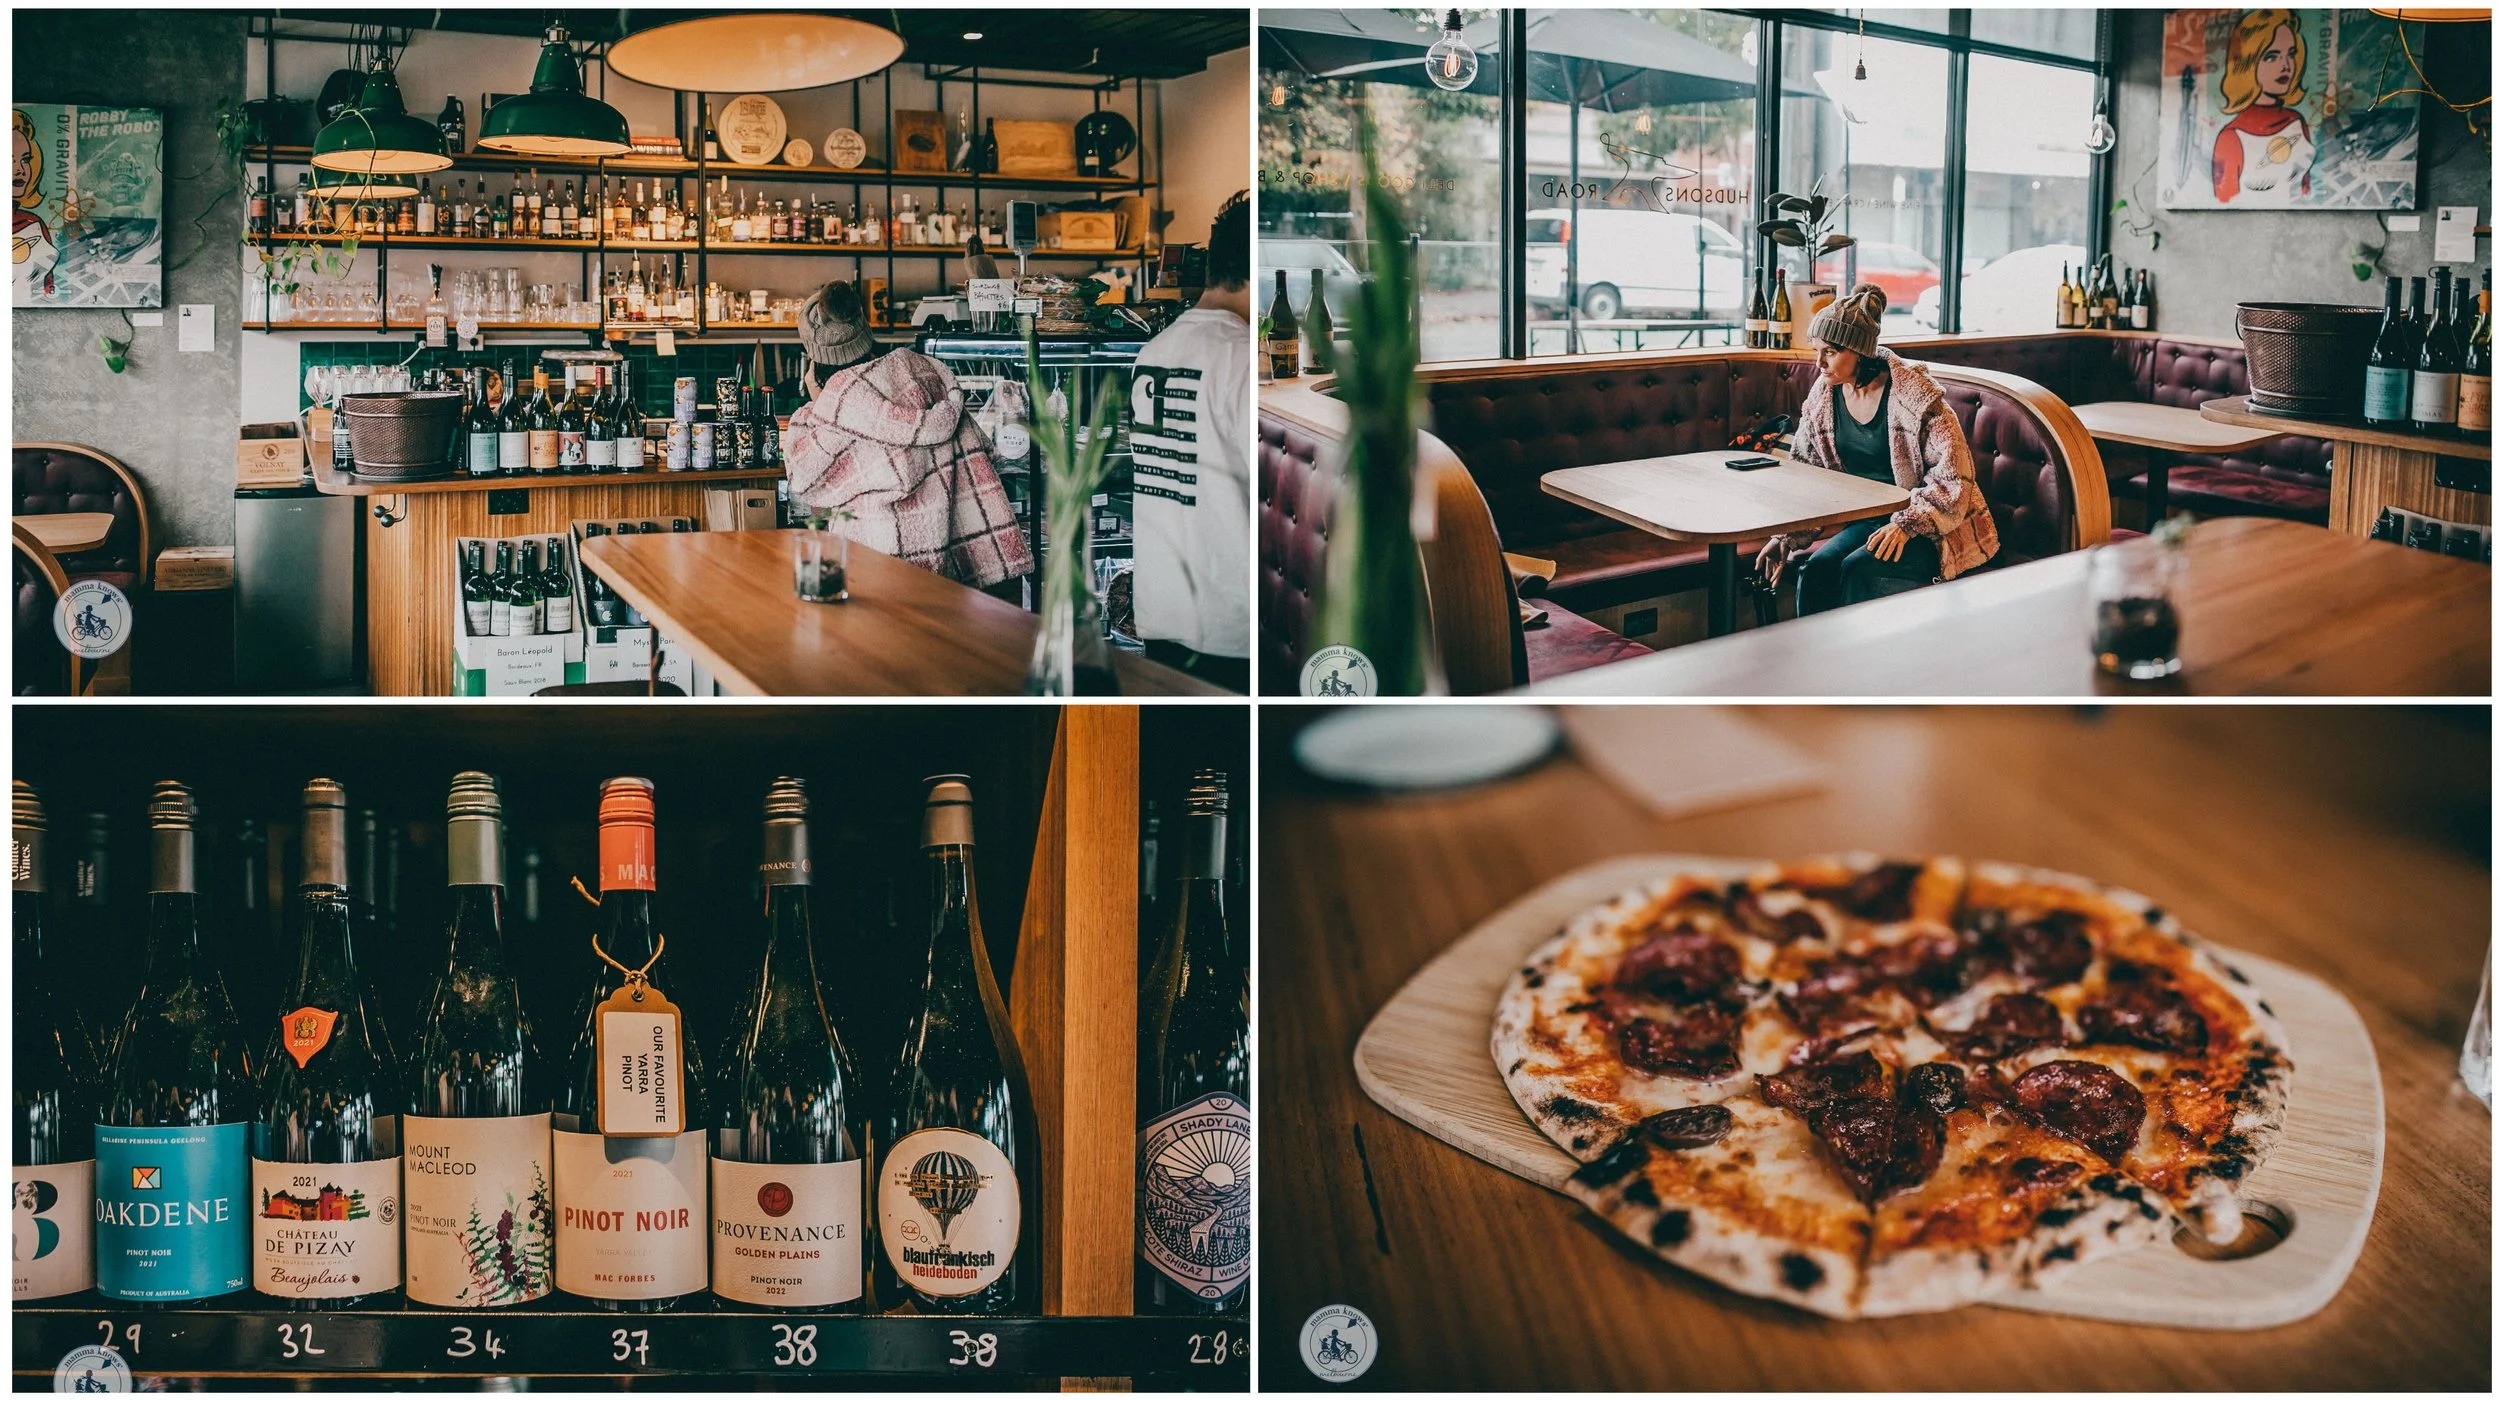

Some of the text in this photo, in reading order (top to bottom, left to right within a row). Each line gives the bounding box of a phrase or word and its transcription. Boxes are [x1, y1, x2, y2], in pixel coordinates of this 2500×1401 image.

[79, 110, 129, 125] ROBBY
[79, 125, 109, 139] THE
[20, 843, 31, 881] Wines.
[293, 1039, 314, 1047] 2021
[622, 1056, 632, 1092] PINOT
[638, 1053, 649, 1094] YARRA
[653, 1025, 666, 1123] OUR FAVOURITE
[1215, 1098, 1227, 1106] 20
[1180, 1117, 1223, 1133] SHADY
[409, 1144, 451, 1159] MOUNT
[410, 1160, 476, 1175] MACLEOD
[613, 1170, 633, 1178] 2021
[292, 1176, 317, 1187] 2021
[96, 1198, 229, 1227] OAKDENE
[565, 1206, 689, 1232] PINOT NOIR
[410, 1213, 456, 1228] PINOT NOIR
[277, 1228, 338, 1240] CHÂTEAU
[717, 1219, 846, 1242] PROVENANCE
[265, 1239, 356, 1257] DE PIZAY
[735, 1247, 820, 1259] GOLDEN PLAINS
[139, 1260, 158, 1268] 2021
[913, 1264, 978, 1279] heideboden
[1164, 1254, 1204, 1277] SHIRAZ
[1218, 1262, 1243, 1277] WINE
[226, 1277, 243, 1289] 750ml
[270, 1267, 348, 1293] Beaujolais
[594, 1274, 656, 1282] MAC FORBES
[750, 1275, 777, 1285] PINOT
[766, 1287, 786, 1295] 2022
[1205, 1289, 1216, 1297] 20
[98, 1320, 142, 1354] 29
[277, 1323, 325, 1358] 32
[447, 1326, 504, 1360] 34
[612, 1328, 650, 1365] 37
[772, 1324, 818, 1367] 38
[949, 1329, 998, 1368] 38
[1188, 1330, 1228, 1365] 28
